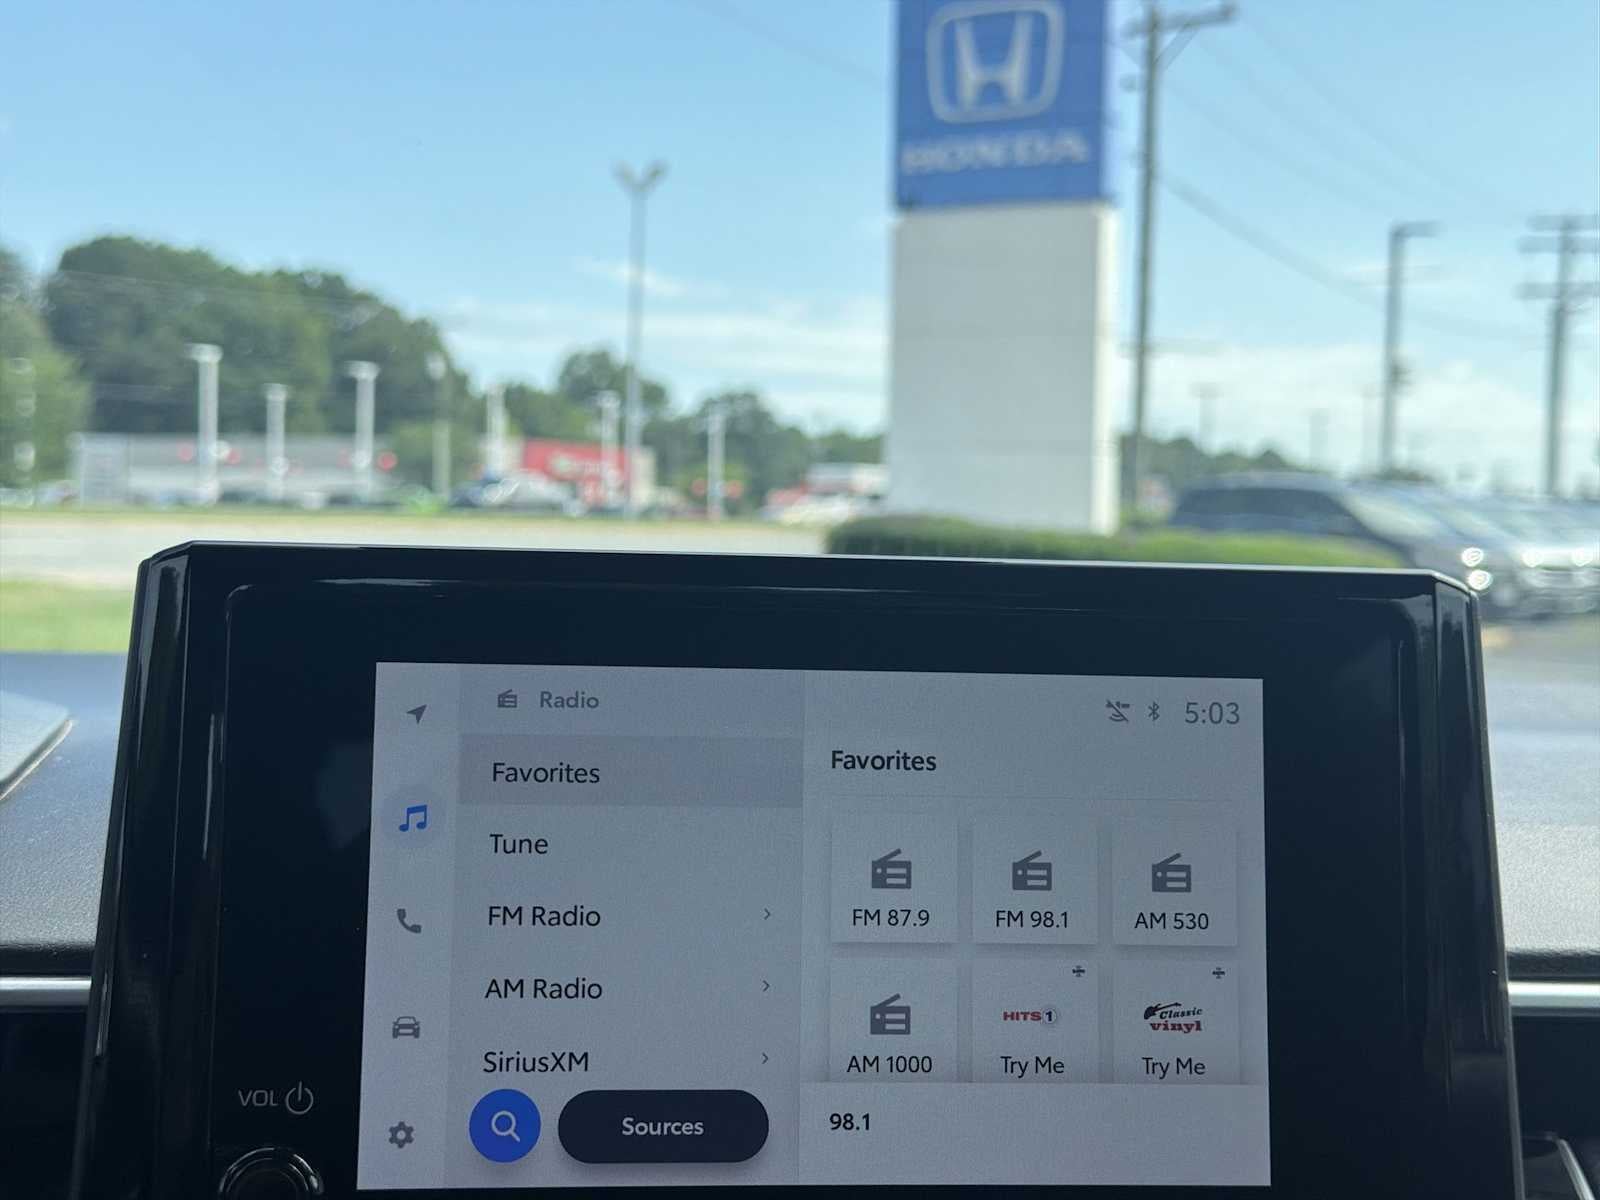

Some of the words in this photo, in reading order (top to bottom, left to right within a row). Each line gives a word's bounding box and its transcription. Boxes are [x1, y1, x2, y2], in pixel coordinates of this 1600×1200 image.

[901, 129, 1090, 174] HONDA
[539, 690, 600, 710] Radio
[1184, 702, 1241, 725] 5:03
[830, 750, 938, 773] Favorites
[491, 762, 601, 784] Favorites
[489, 834, 550, 855] Tune
[488, 906, 524, 926] FM
[532, 905, 602, 928] Radio
[852, 909, 881, 927] FM
[887, 908, 930, 927] 87.9
[996, 910, 1025, 929] FM
[1030, 910, 1069, 930] 98.1
[1134, 912, 1168, 931] AM
[1172, 912, 1210, 931] 530
[485, 979, 525, 999] AM
[533, 978, 604, 1001] Radio
[1003, 1010, 1041, 1022] HITS
[1159, 1004, 1203, 1020] Classic
[1150, 1018, 1203, 1034] vinyl
[483, 1051, 590, 1073] SiriusXM
[846, 1056, 881, 1074] AM
[885, 1055, 933, 1075] 1000
[1001, 1056, 1030, 1079] Try
[1034, 1056, 1065, 1075] Me
[1142, 1057, 1171, 1079] Try
[1175, 1058, 1206, 1076] Me
[238, 1090, 278, 1107] VOL
[621, 1116, 704, 1137] Sources
[829, 1112, 871, 1132] 98.1
